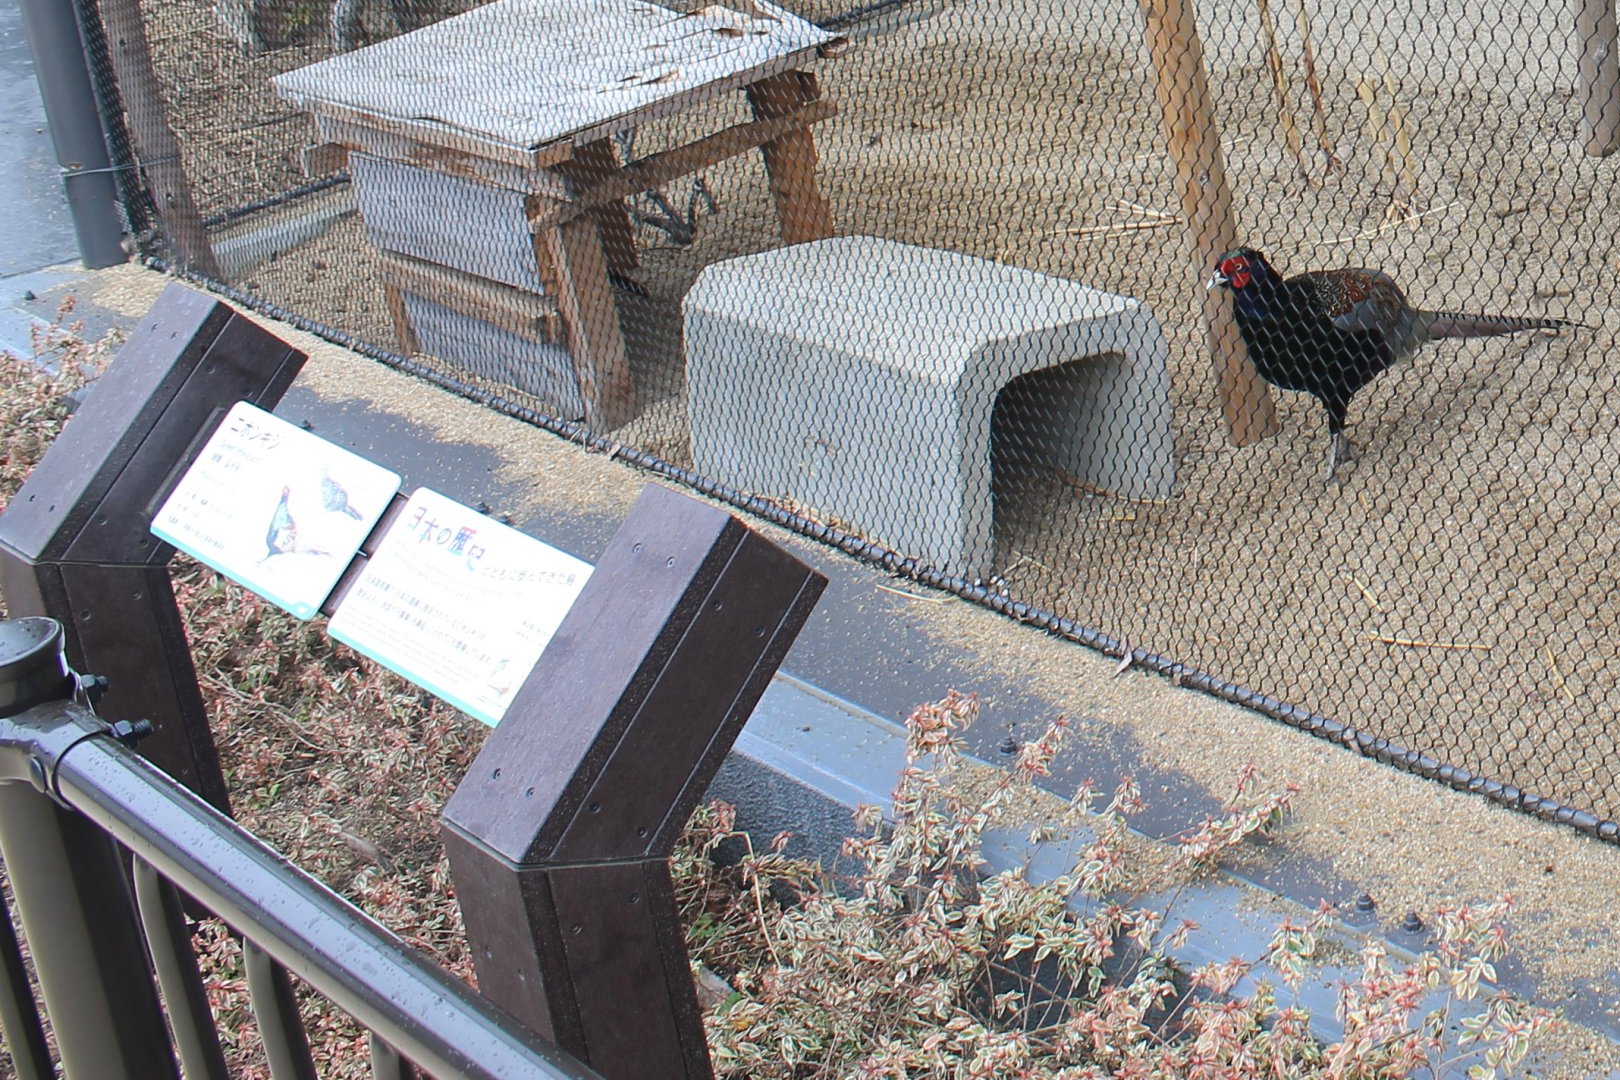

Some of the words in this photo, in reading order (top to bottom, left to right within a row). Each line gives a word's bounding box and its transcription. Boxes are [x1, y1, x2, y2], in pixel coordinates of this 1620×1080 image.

[231, 418, 286, 450] ニホンキジ
[406, 506, 486, 572] 日本の歴史
